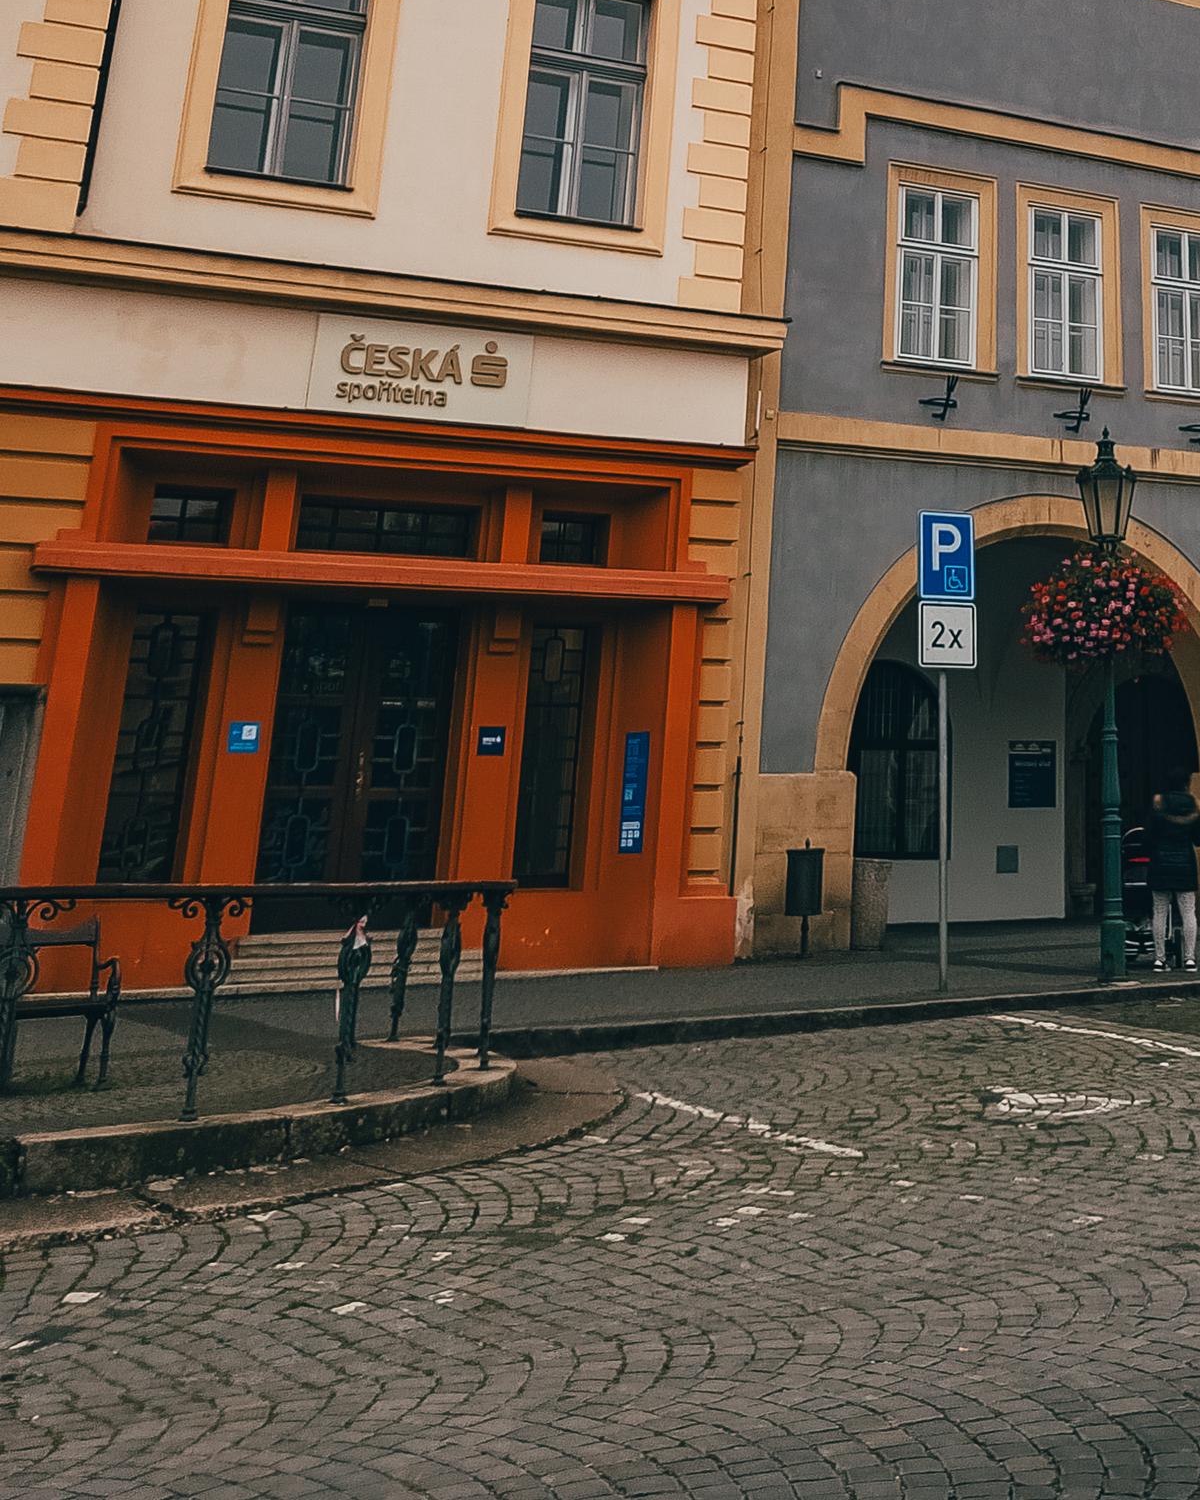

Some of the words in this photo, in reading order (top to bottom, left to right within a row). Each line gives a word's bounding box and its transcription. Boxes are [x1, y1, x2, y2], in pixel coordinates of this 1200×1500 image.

[340, 333, 463, 385] ČESKÁ
[335, 379, 448, 408] spořitelna
[932, 523, 962, 571] P
[931, 620, 963, 649] 2x
